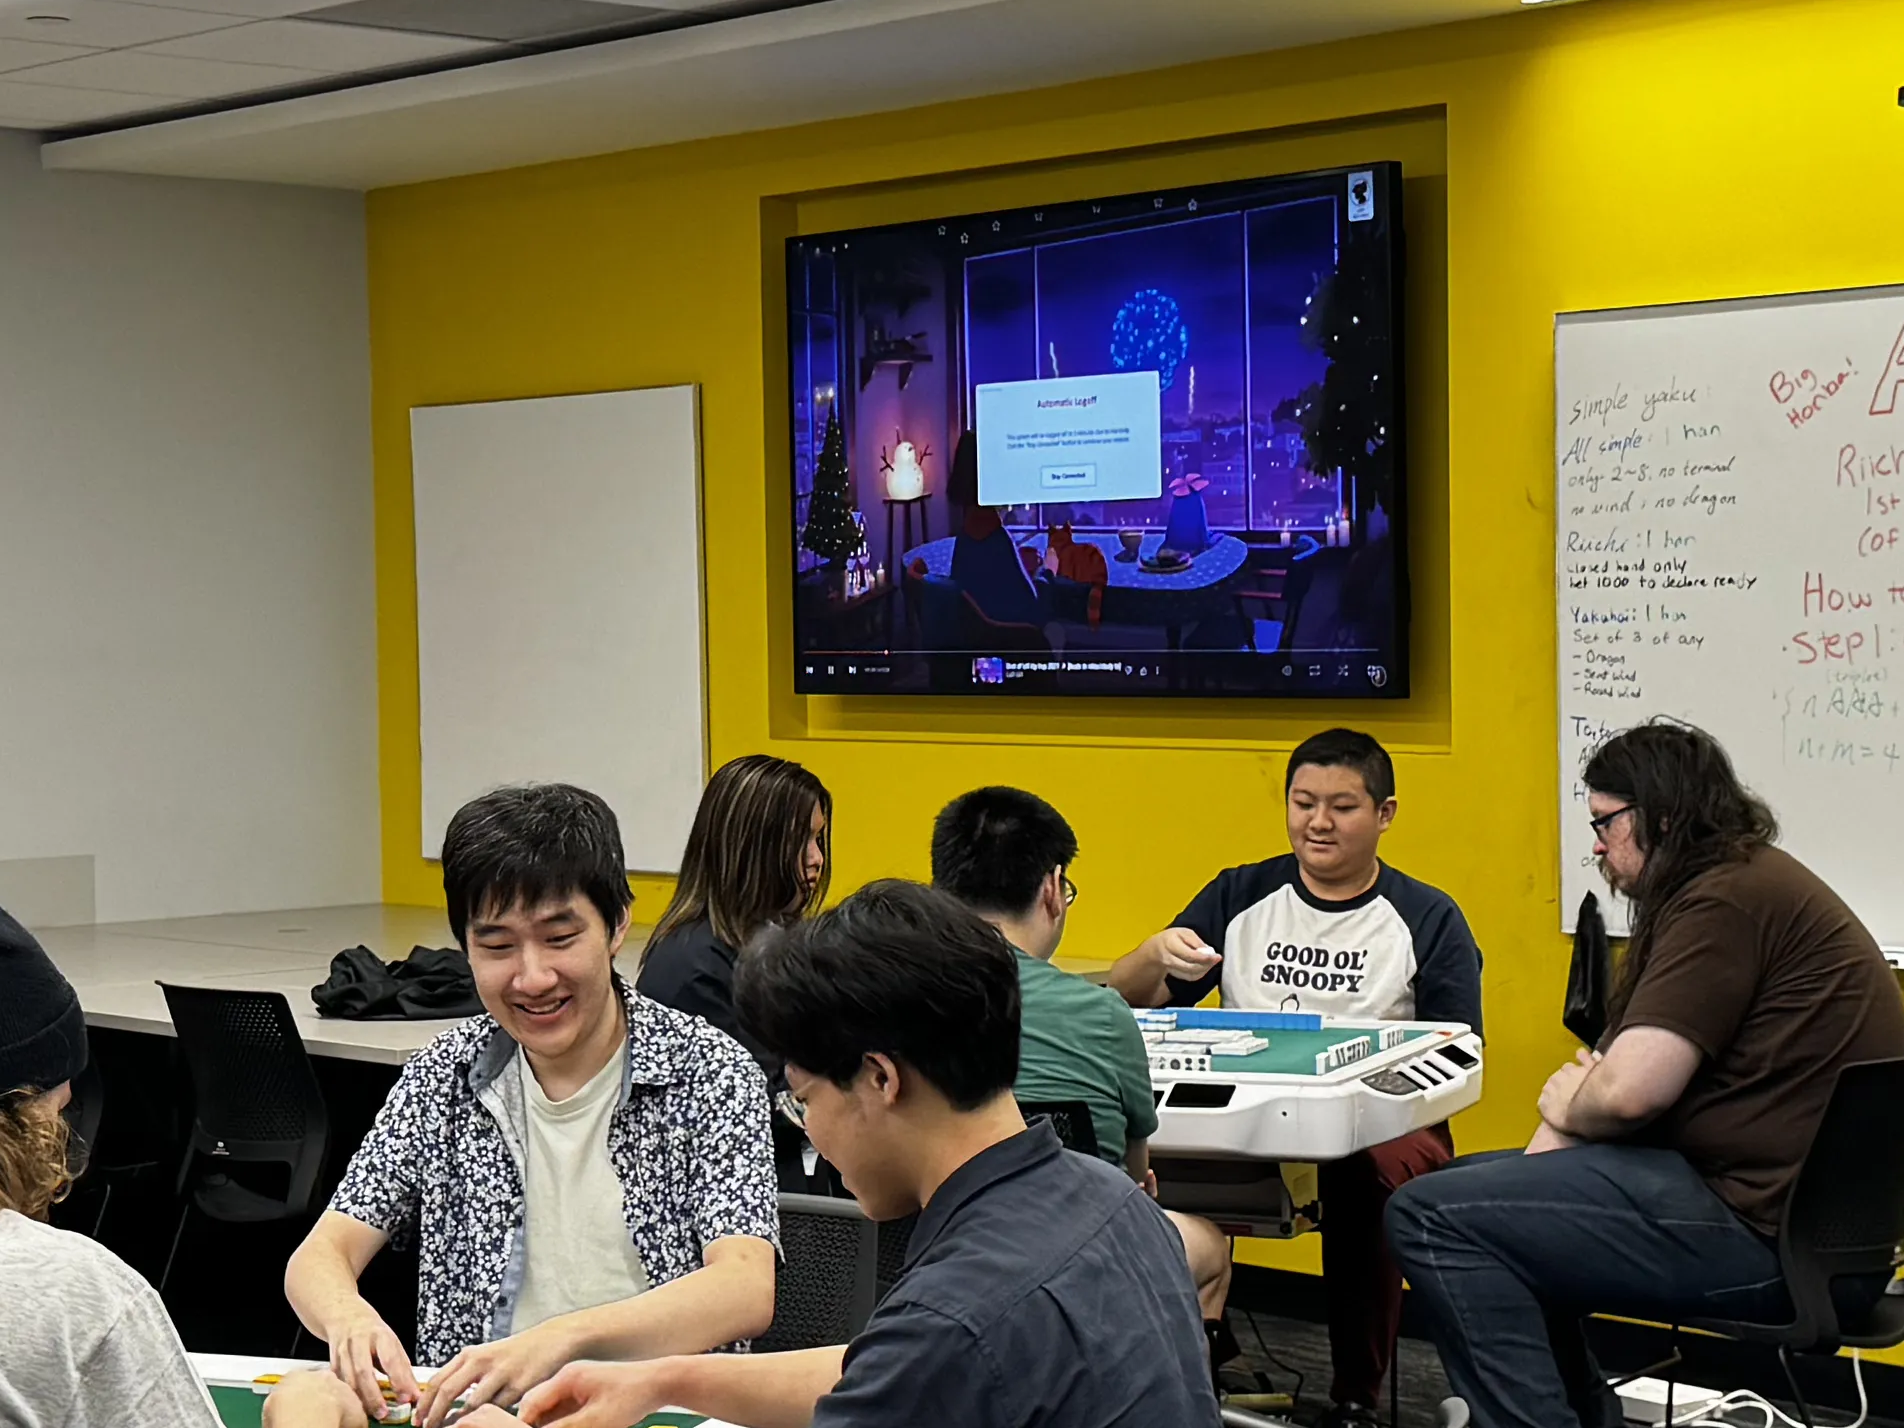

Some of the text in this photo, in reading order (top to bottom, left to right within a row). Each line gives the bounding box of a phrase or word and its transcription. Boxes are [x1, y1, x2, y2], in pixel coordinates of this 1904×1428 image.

[1769, 369, 1818, 405] Big
[1562, 436, 1593, 466] All
[1683, 423, 1722, 441] han
[1653, 557, 1688, 574] only
[1596, 576, 1630, 589] 1000
[1639, 575, 1656, 589] to
[1802, 572, 1874, 617] How
[1633, 631, 1643, 644] 3
[1266, 941, 1369, 971] GOOD OL'
[1260, 963, 1365, 994] SNOOPY
